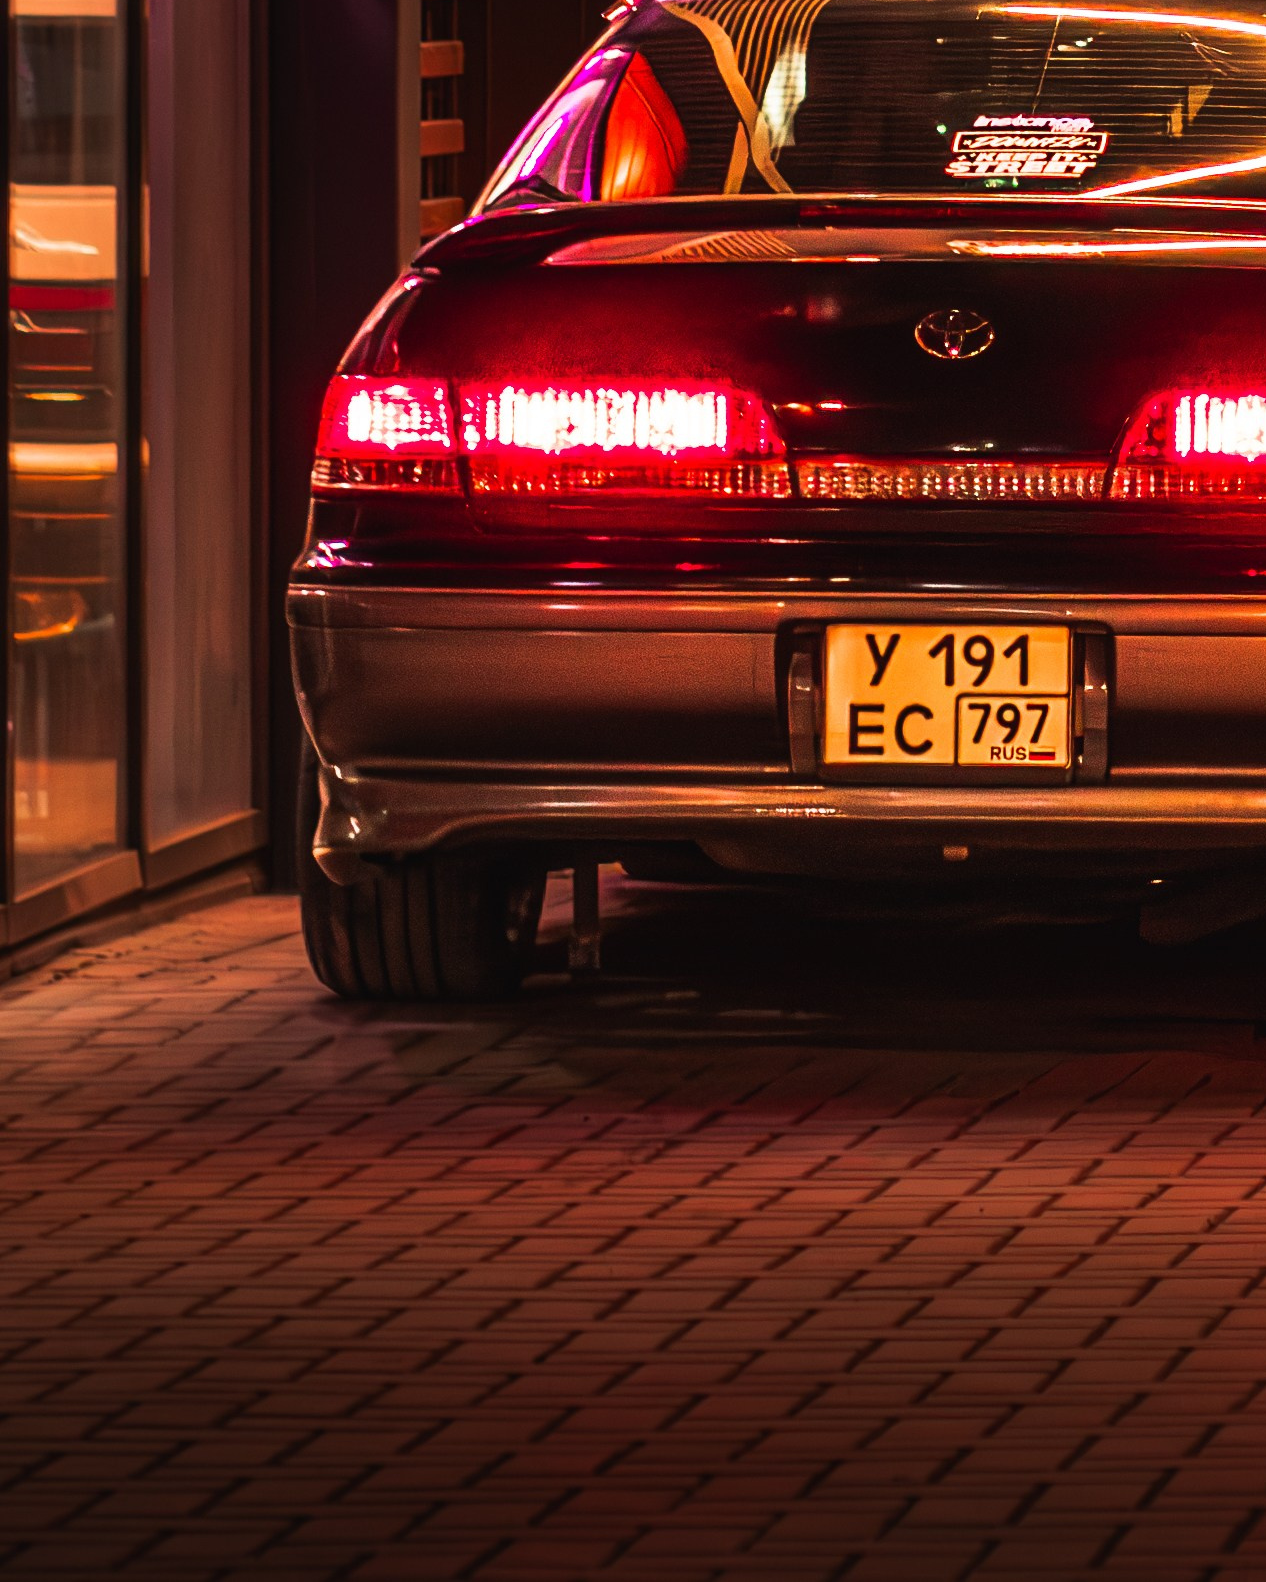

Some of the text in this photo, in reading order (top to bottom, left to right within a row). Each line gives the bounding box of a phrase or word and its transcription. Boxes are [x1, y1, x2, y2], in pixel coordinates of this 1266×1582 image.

[1051, 152, 1081, 162] IT
[945, 161, 1097, 174] STREET
[928, 633, 1030, 687] 191
[967, 702, 1050, 744] 797
[989, 746, 1027, 761] RUS
